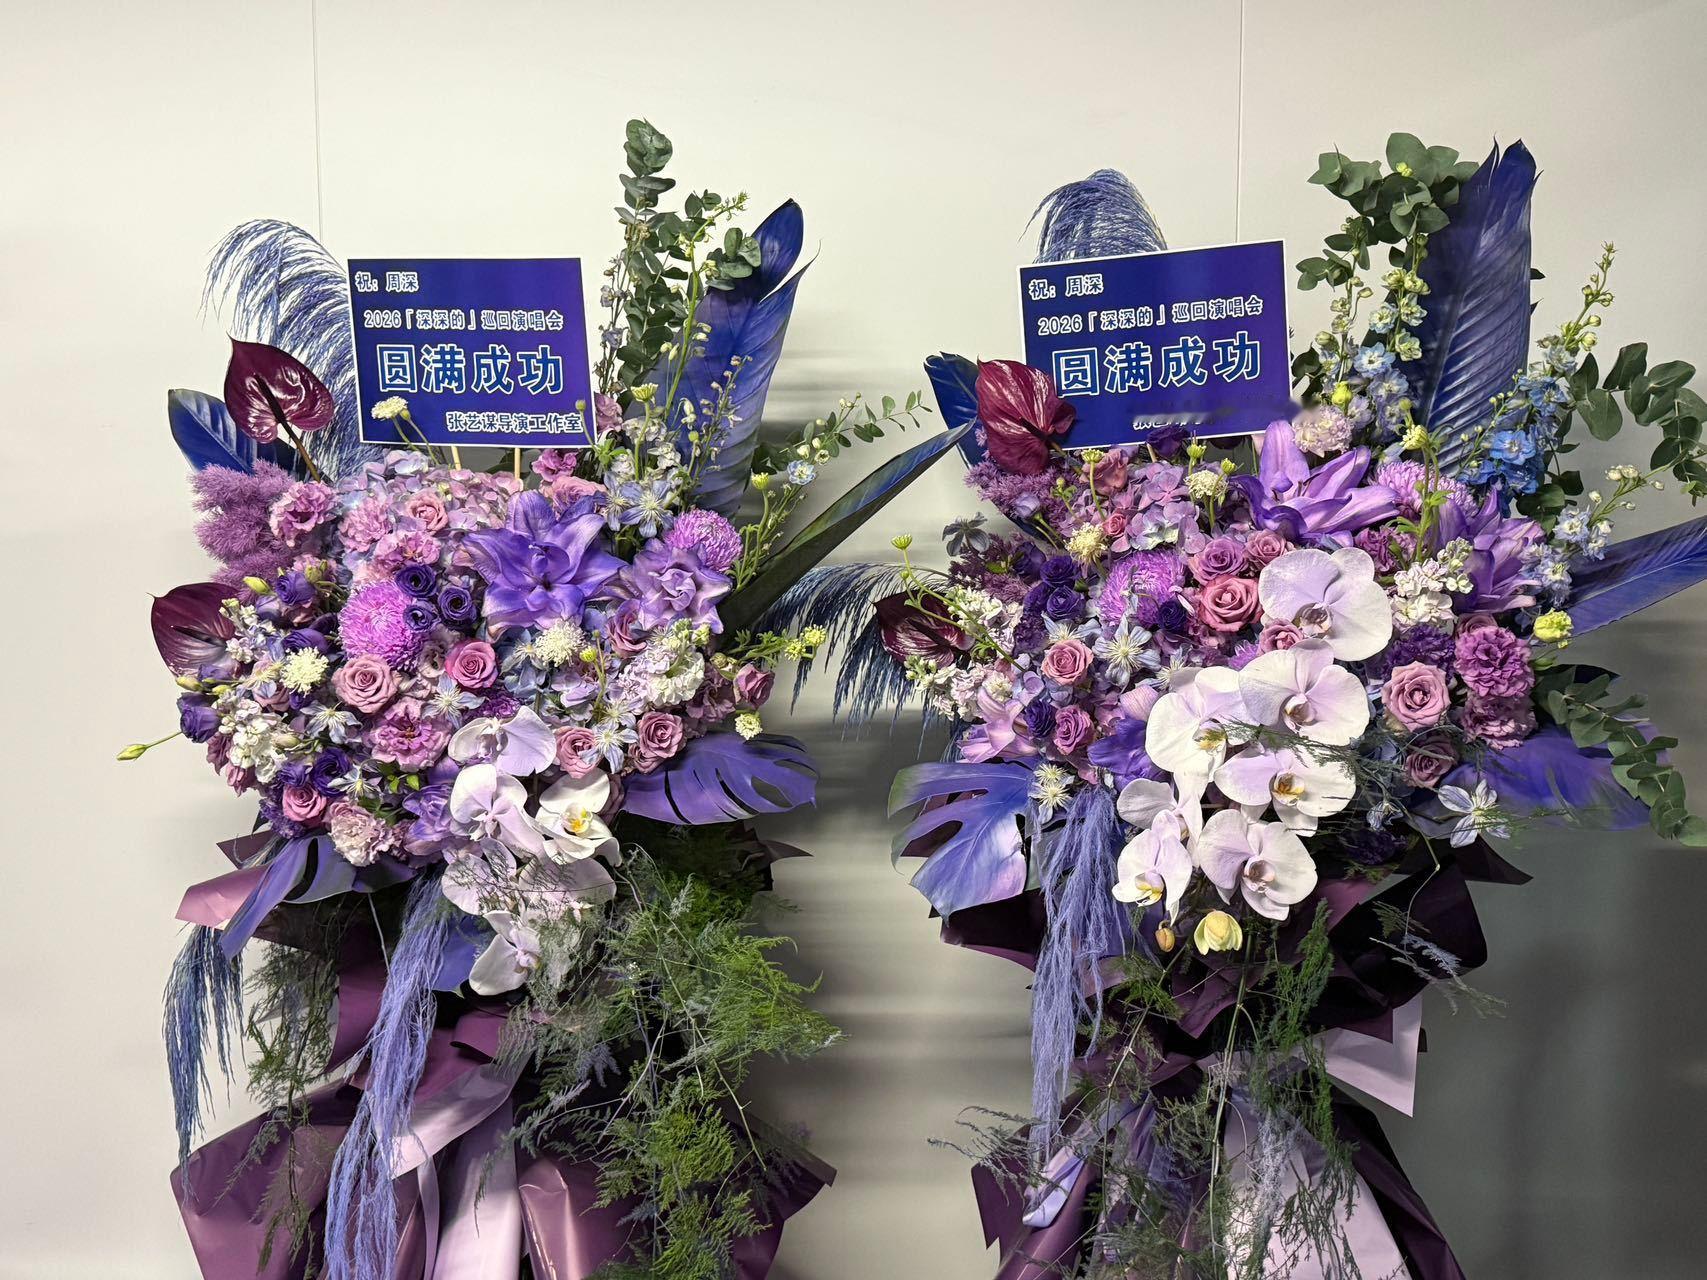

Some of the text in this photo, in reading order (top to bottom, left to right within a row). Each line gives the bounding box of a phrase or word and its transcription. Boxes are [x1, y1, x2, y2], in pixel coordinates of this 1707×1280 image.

[376, 344, 565, 395] 圆满成功
[1051, 330, 1261, 399] 圆满成功
[446, 411, 584, 434] 张艺谋导演工作室
